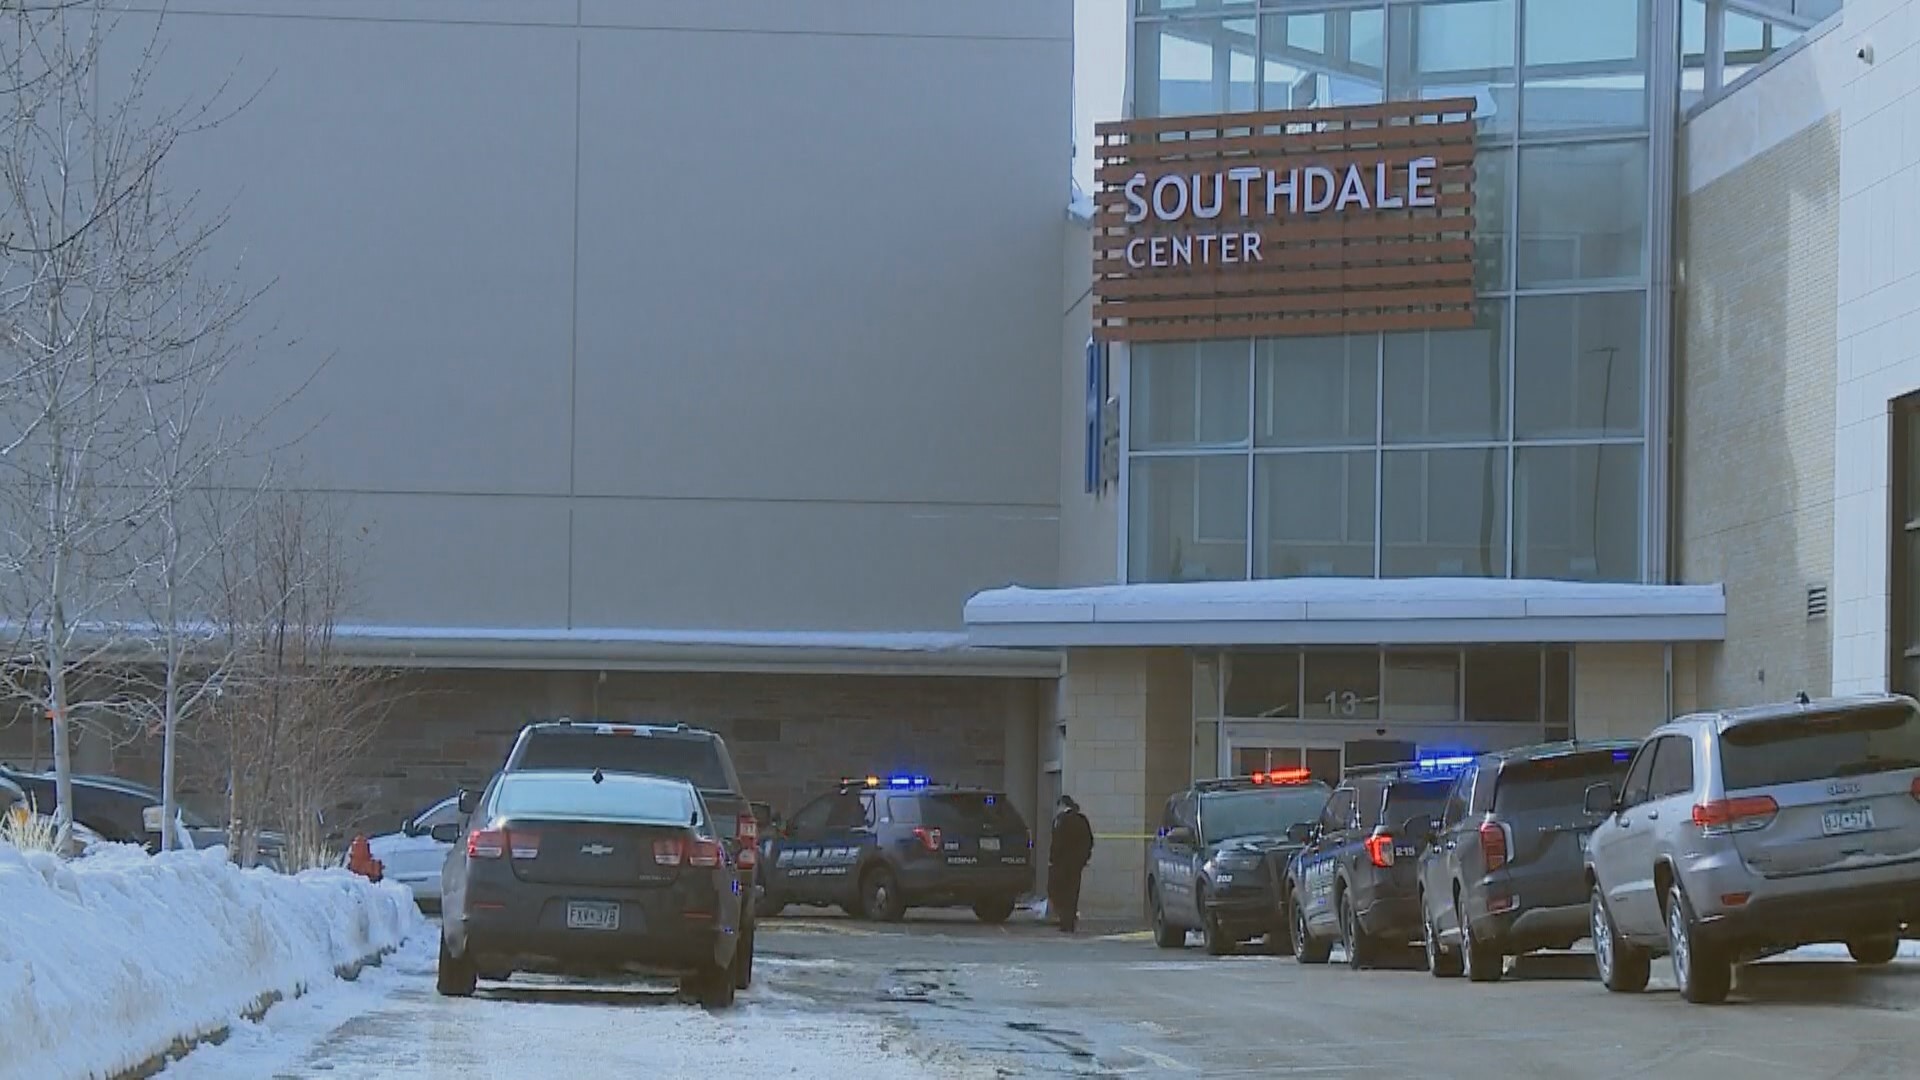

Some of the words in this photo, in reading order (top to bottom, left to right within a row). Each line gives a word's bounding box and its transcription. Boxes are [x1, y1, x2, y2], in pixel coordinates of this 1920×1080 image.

[1124, 157, 1437, 223] SOUTHDALE
[1125, 233, 1263, 268] CENTER
[1325, 690, 1356, 715] 13
[947, 856, 978, 865] EDINA
[1000, 856, 1027, 865] POLICE
